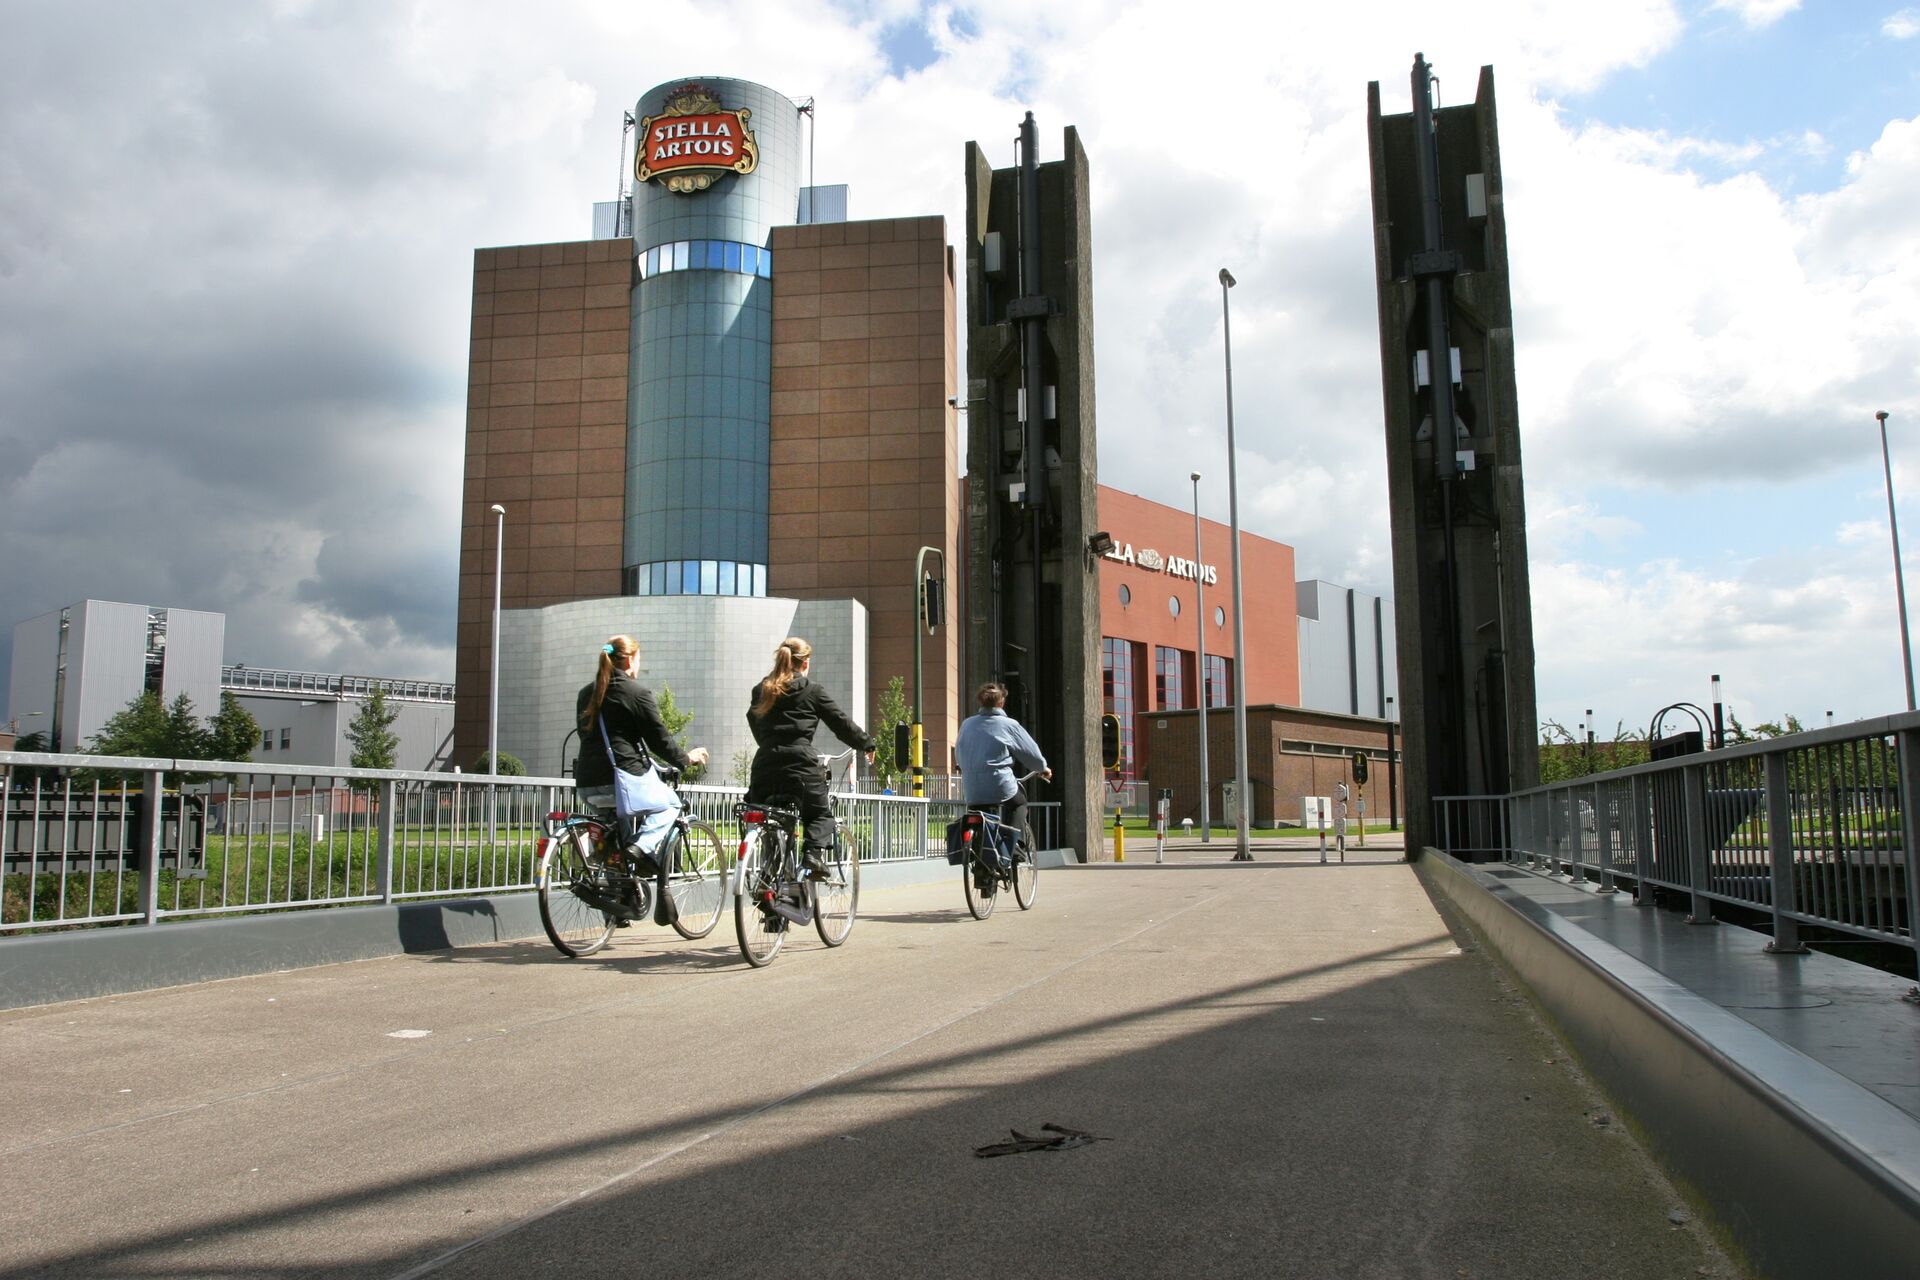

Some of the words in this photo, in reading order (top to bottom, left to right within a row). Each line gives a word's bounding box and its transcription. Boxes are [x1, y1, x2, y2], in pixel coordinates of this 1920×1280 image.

[655, 121, 731, 142] STELLA
[654, 140, 734, 161] ARTOIS
[1166, 555, 1217, 584] ARTOIS
